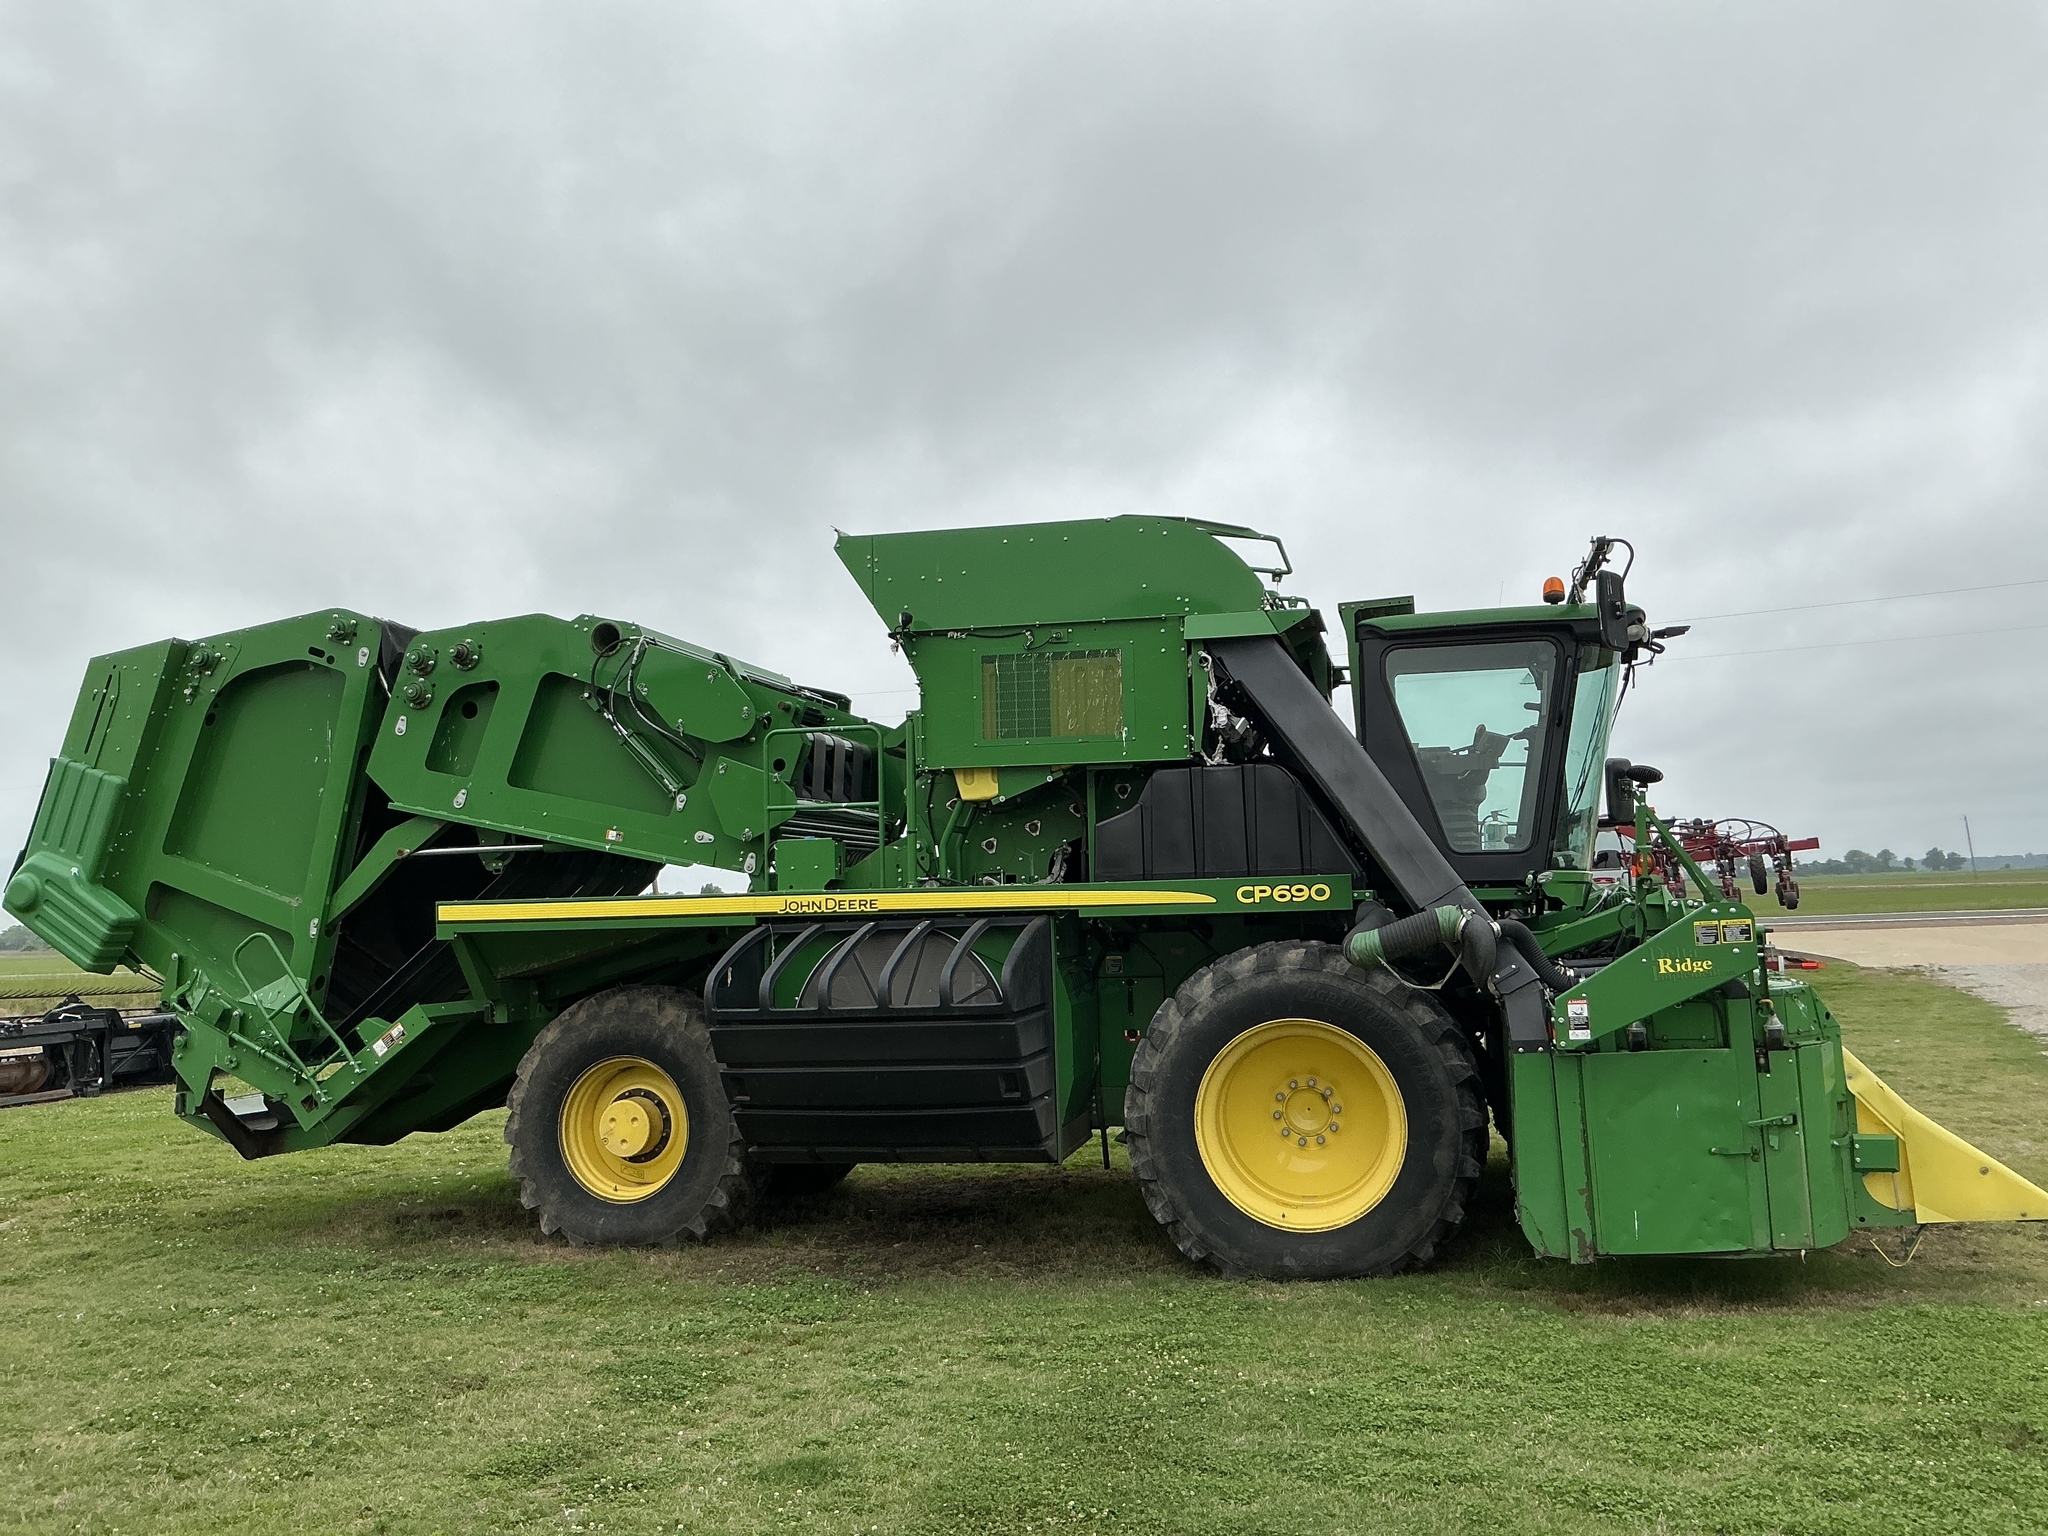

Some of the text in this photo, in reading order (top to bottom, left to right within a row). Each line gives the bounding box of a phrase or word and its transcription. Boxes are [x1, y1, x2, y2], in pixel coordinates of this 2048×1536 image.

[1236, 883, 1331, 904] CP690
[779, 897, 879, 912] JOHN DEERE
[1657, 957, 1713, 974] Ridge
